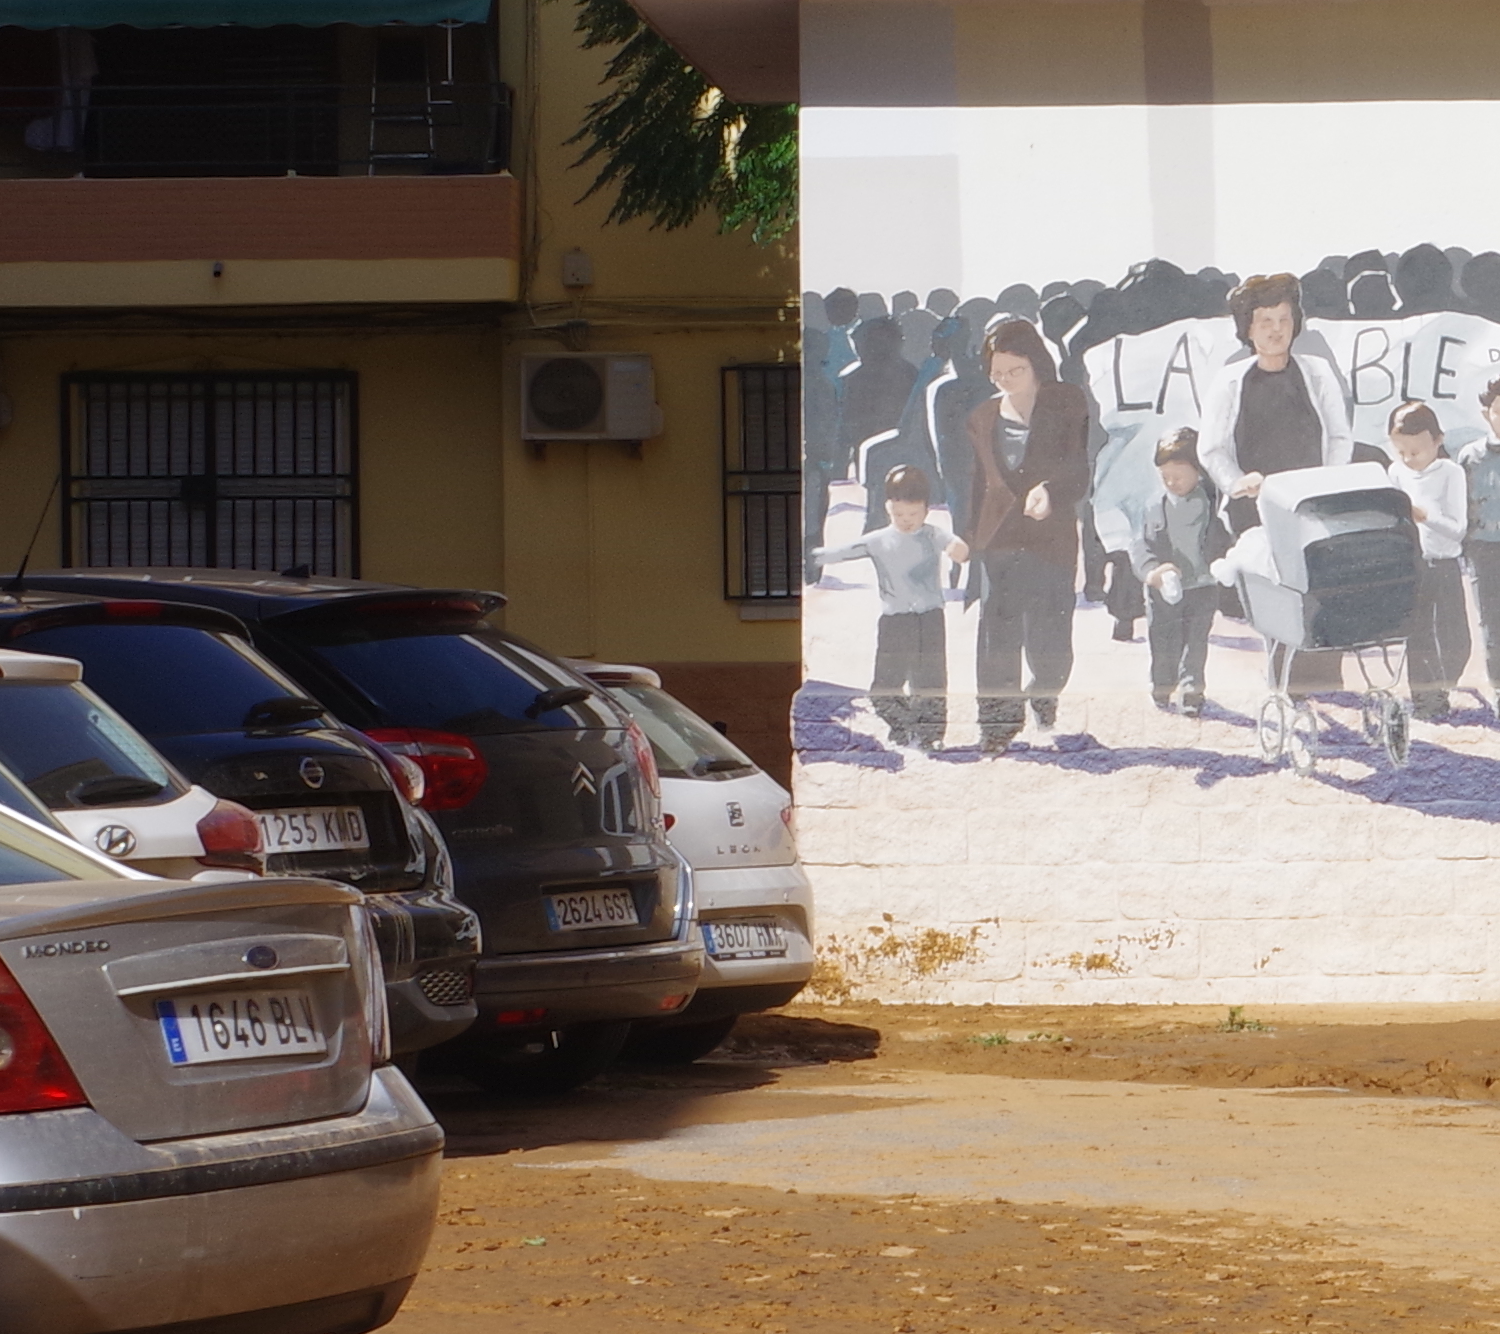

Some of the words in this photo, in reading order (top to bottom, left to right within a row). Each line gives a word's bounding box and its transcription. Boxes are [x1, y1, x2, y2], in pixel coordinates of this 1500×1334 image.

[1114, 332, 1202, 419] LA
[1350, 327, 1468, 407] BLE
[260, 813, 317, 847] 1255
[557, 896, 603, 926] 2624
[603, 892, 633, 921] GST
[20, 940, 111, 959] MONDEO
[714, 922, 751, 949] 3607
[191, 999, 267, 1053] 1646
